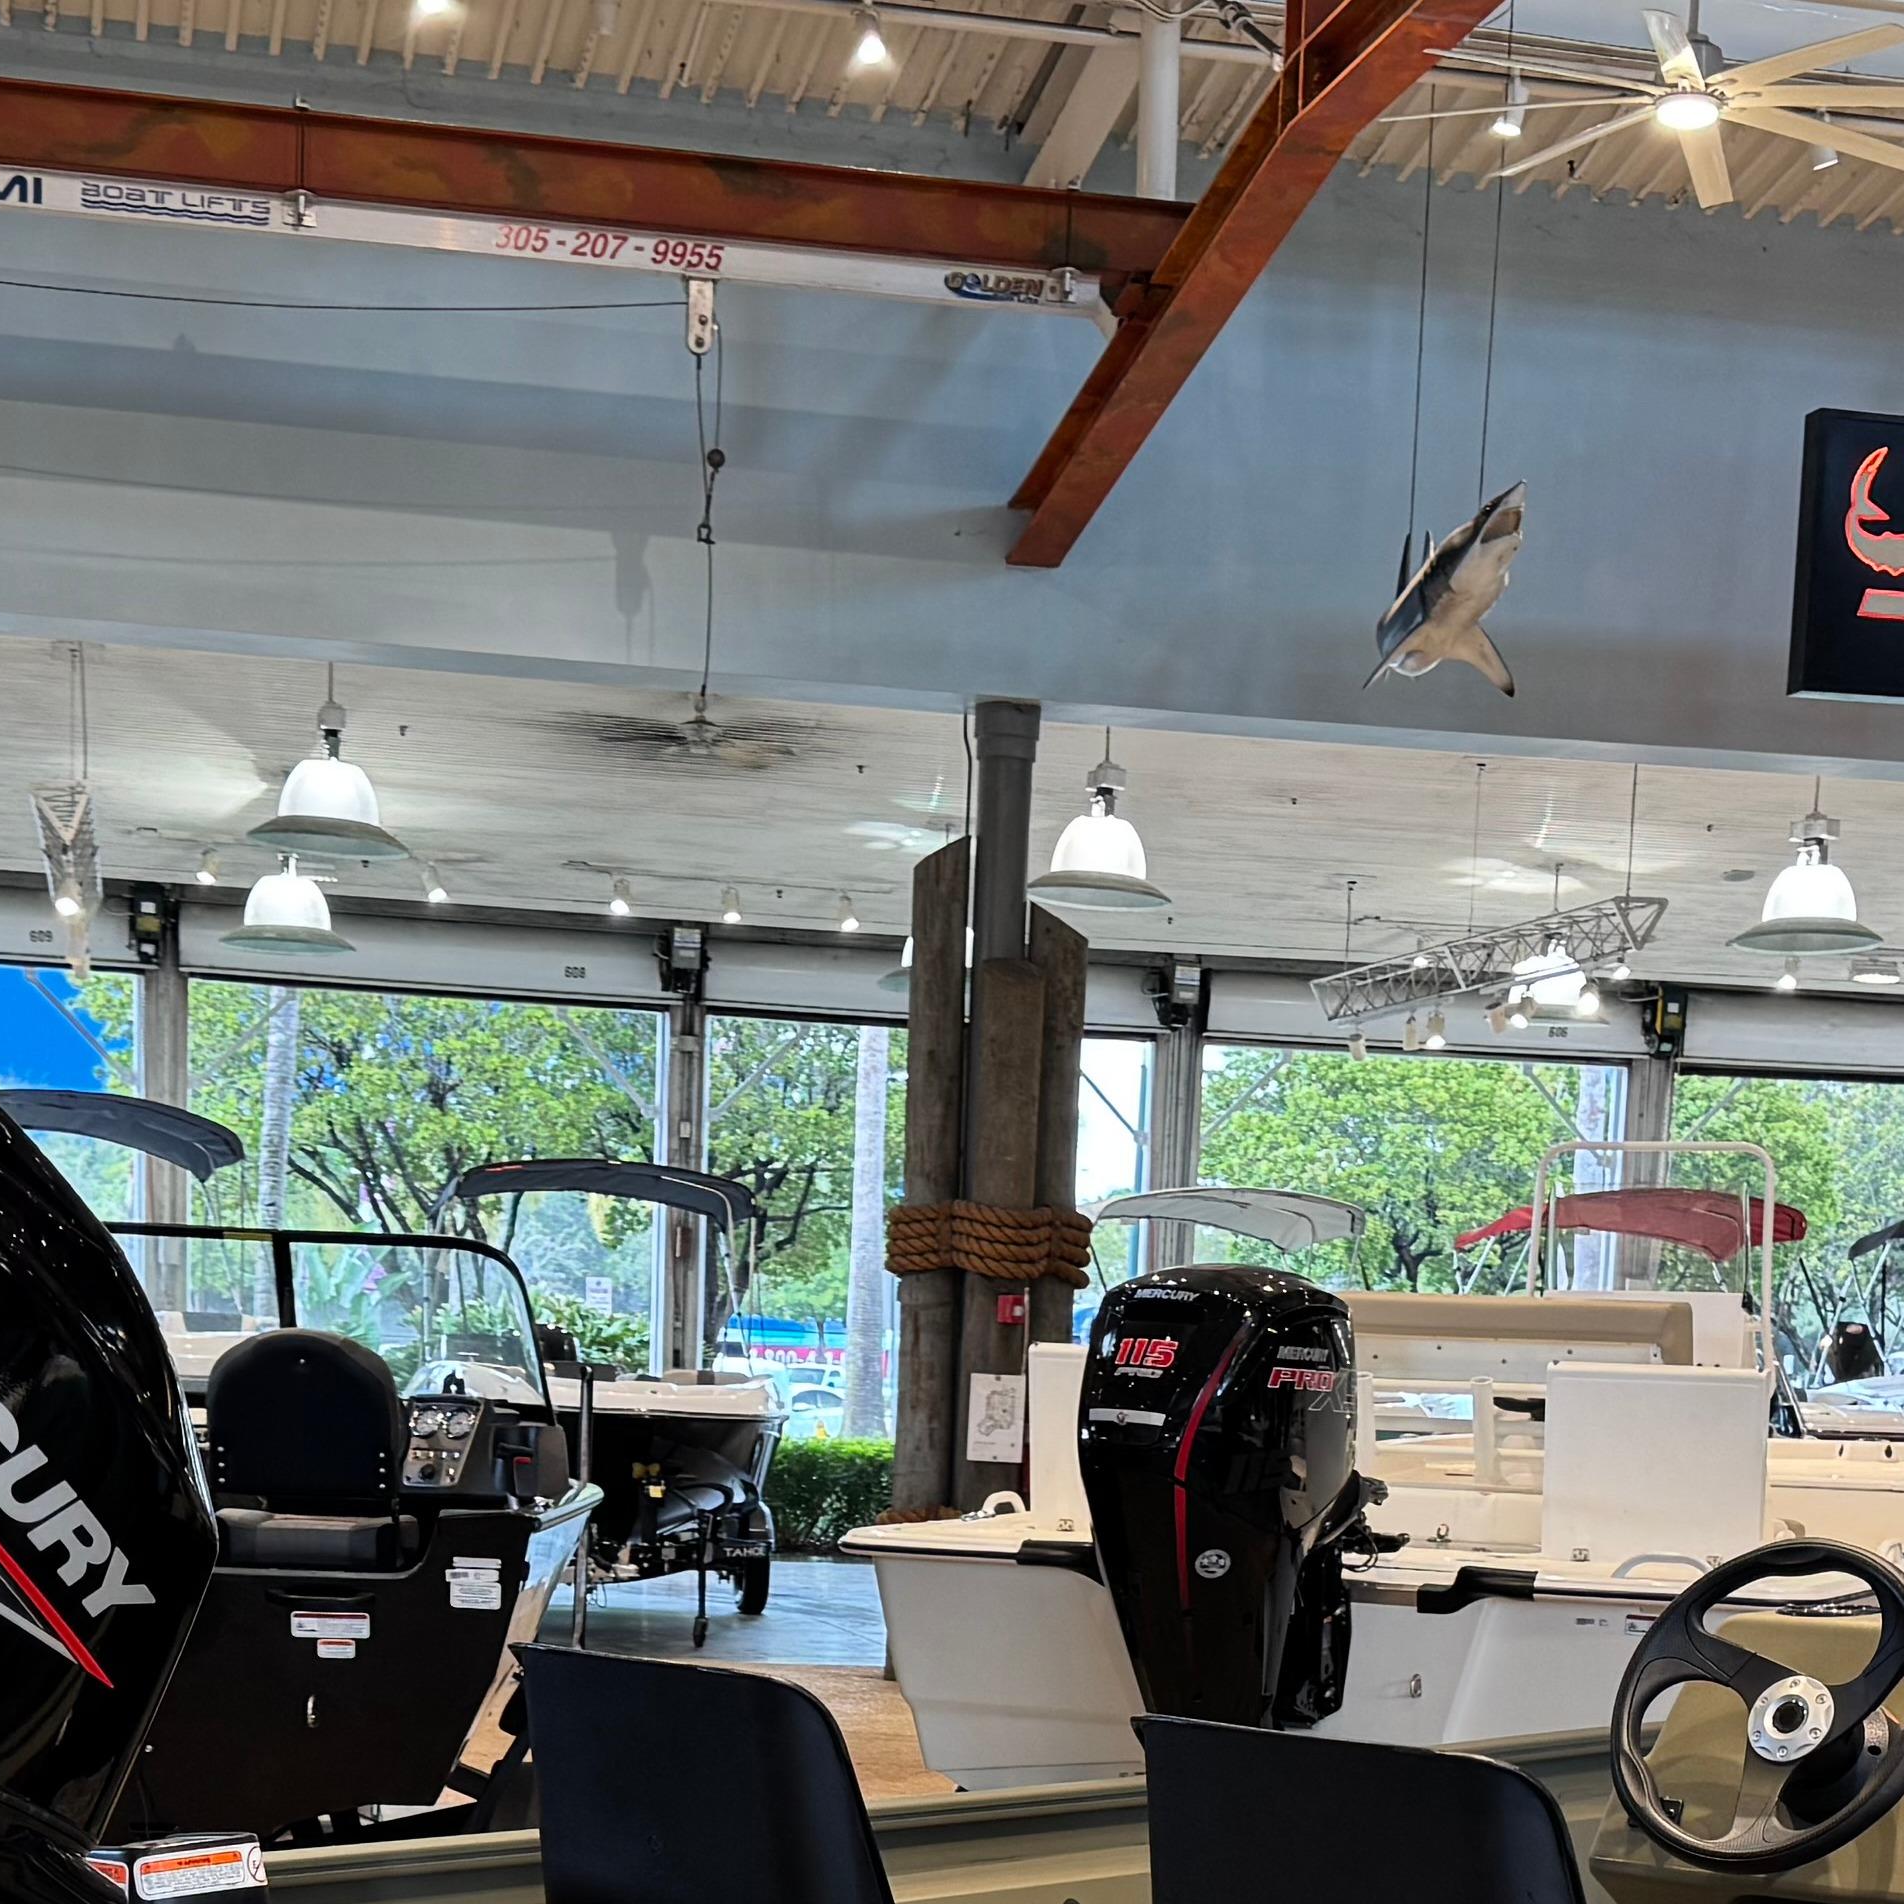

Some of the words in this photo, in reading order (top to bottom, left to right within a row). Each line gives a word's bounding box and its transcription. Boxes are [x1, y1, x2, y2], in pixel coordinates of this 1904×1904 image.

[181, 191, 271, 214] LIFTS
[1134, 1288, 1201, 1302] MERCURY
[1114, 1337, 1179, 1368] 115
[1267, 1366, 1336, 1393] PRO
